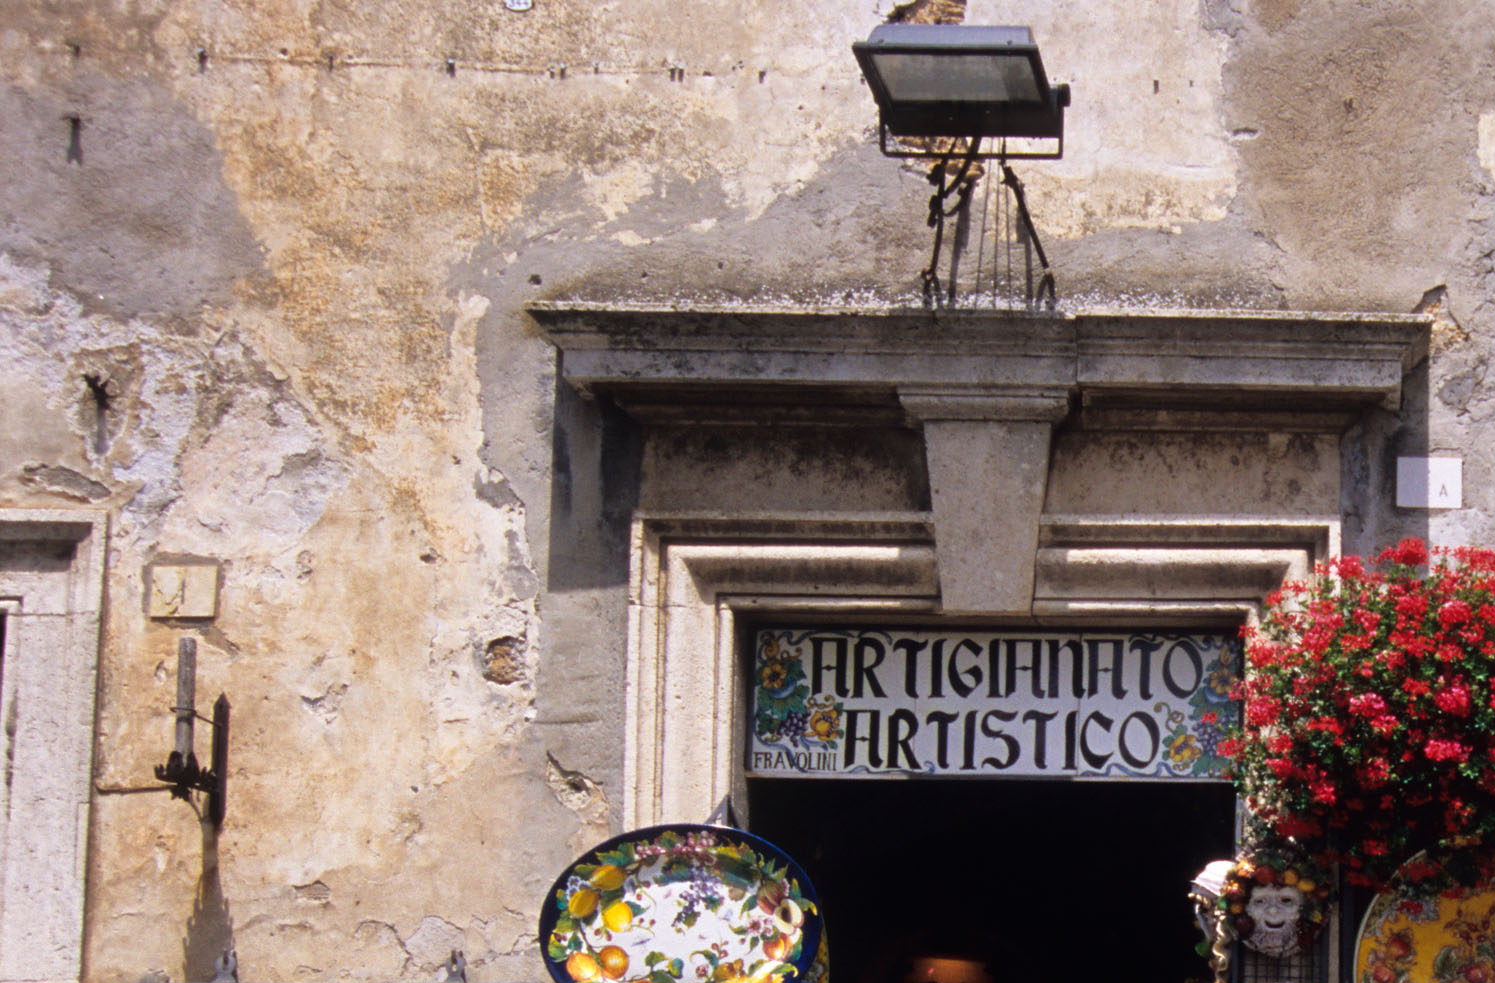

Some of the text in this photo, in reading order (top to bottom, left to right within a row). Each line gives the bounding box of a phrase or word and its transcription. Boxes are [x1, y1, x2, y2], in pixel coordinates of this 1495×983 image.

[808, 636, 1203, 700] ARTIGIANATO
[753, 751, 837, 771] FRAVOLINI
[842, 707, 1161, 771] ARTISTICO
